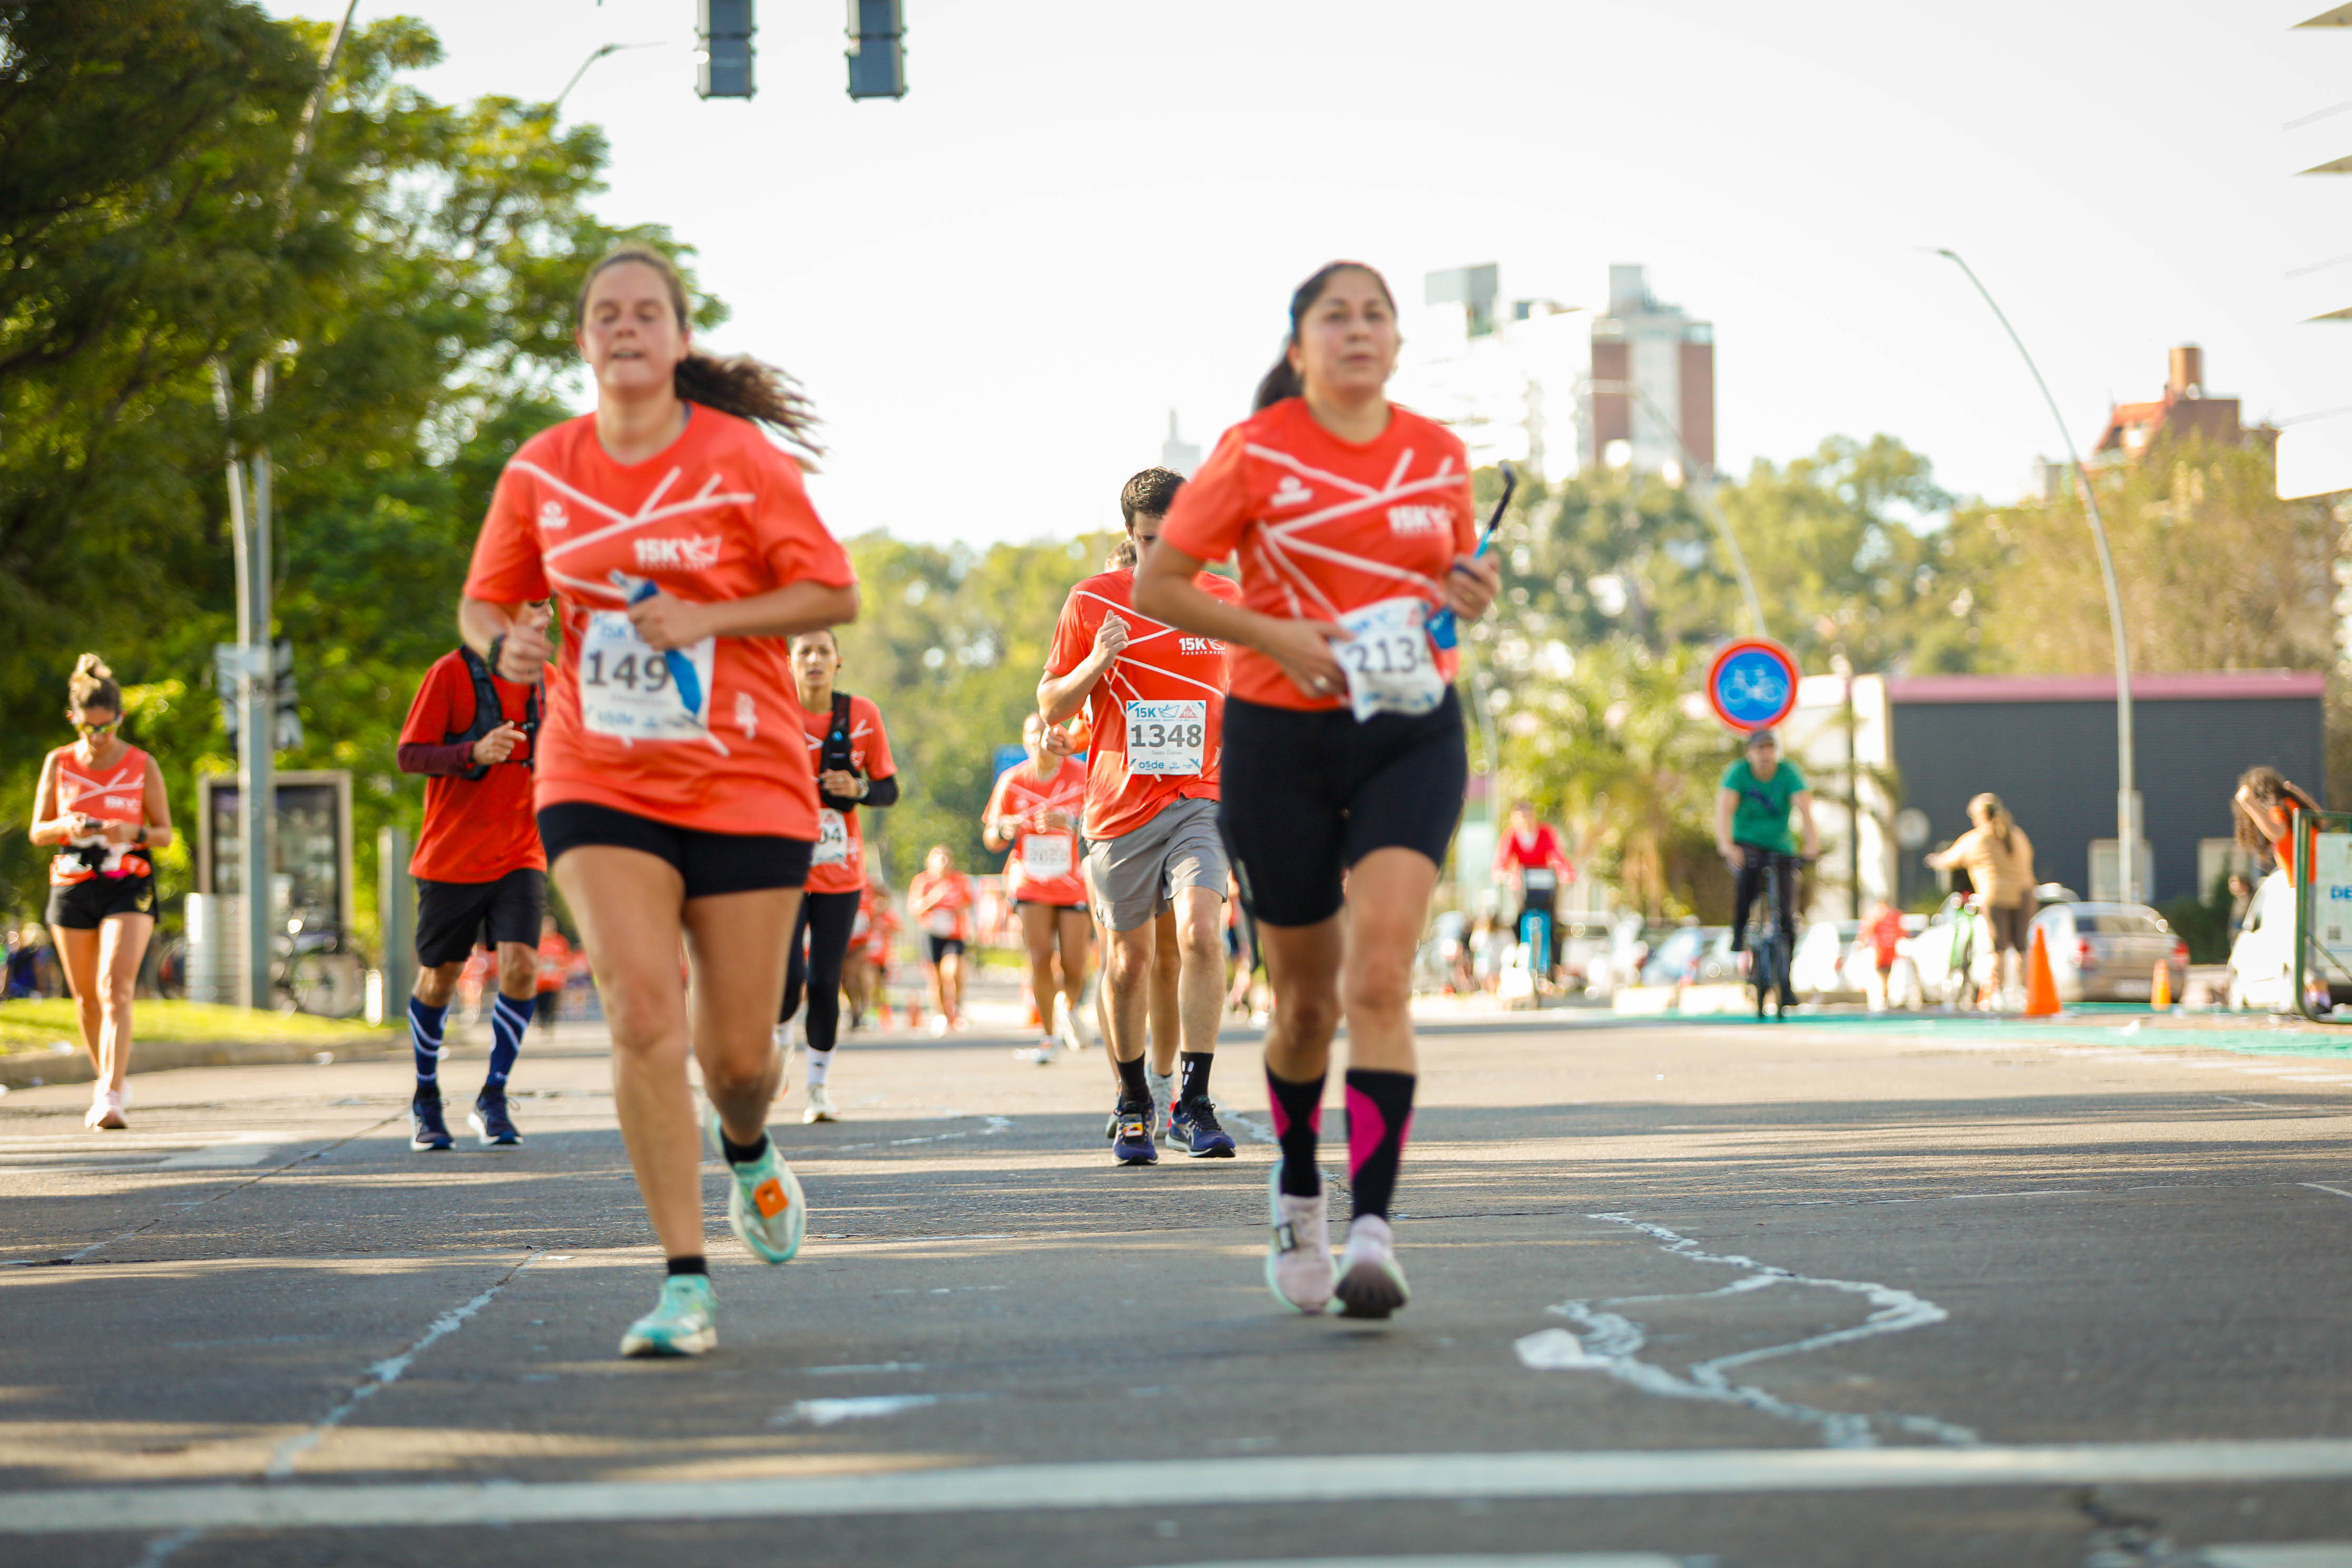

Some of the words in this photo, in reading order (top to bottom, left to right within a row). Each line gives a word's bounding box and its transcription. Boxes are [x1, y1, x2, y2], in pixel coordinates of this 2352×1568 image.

[1179, 637, 1208, 651] 15K
[1346, 636, 1426, 674] 213
[586, 651, 672, 692] 149
[1134, 707, 1157, 718] 15K
[1131, 724, 1202, 748] 1348
[1139, 760, 1164, 770] osde
